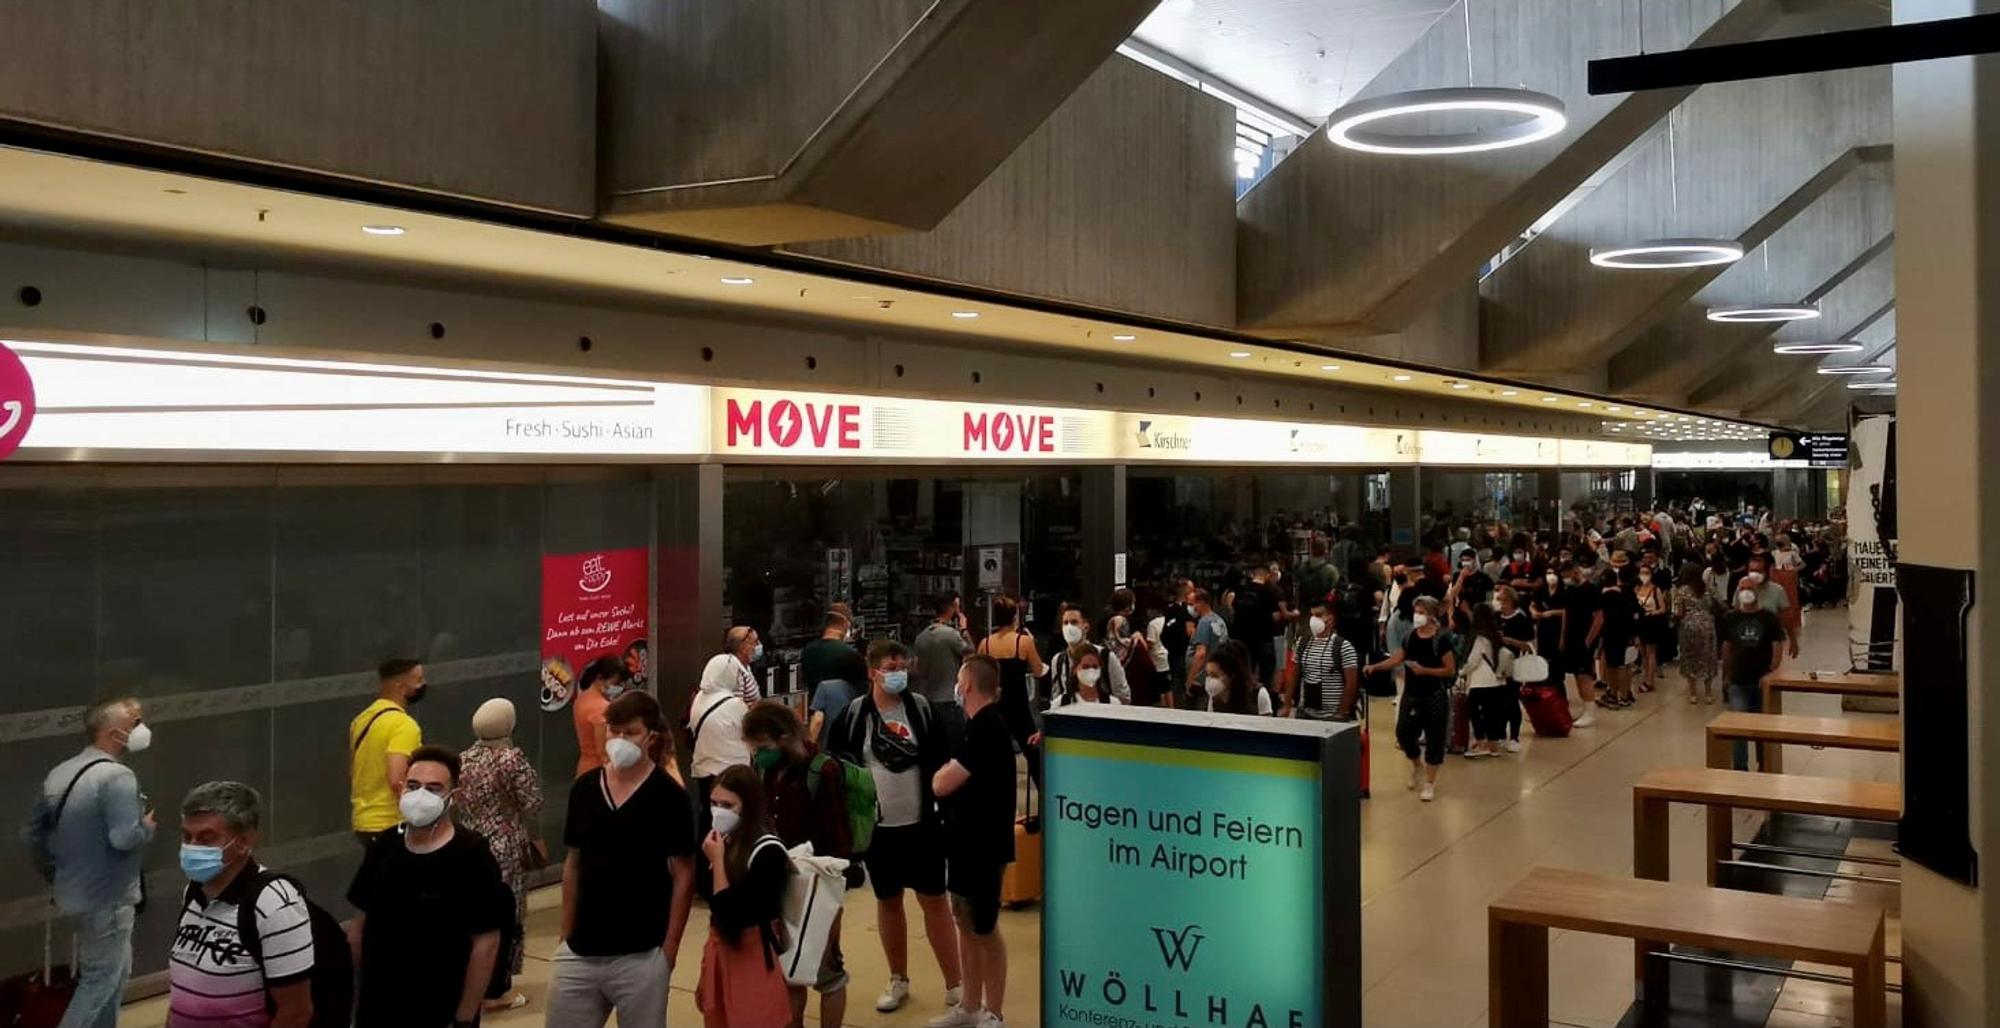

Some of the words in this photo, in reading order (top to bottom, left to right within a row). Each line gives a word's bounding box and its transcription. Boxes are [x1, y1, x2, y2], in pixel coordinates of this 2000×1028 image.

[506, 418, 551, 437] Fresh
[562, 420, 602, 439] Sushi
[612, 422, 653, 439] Asian
[726, 398, 861, 449] MOVE
[963, 411, 1055, 452] MOVE
[1056, 795, 1137, 829] Tagen
[1149, 809, 1201, 836] und
[1213, 813, 1303, 848] Feiern
[1109, 838, 1140, 866] im
[1150, 843, 1248, 880] Airport
